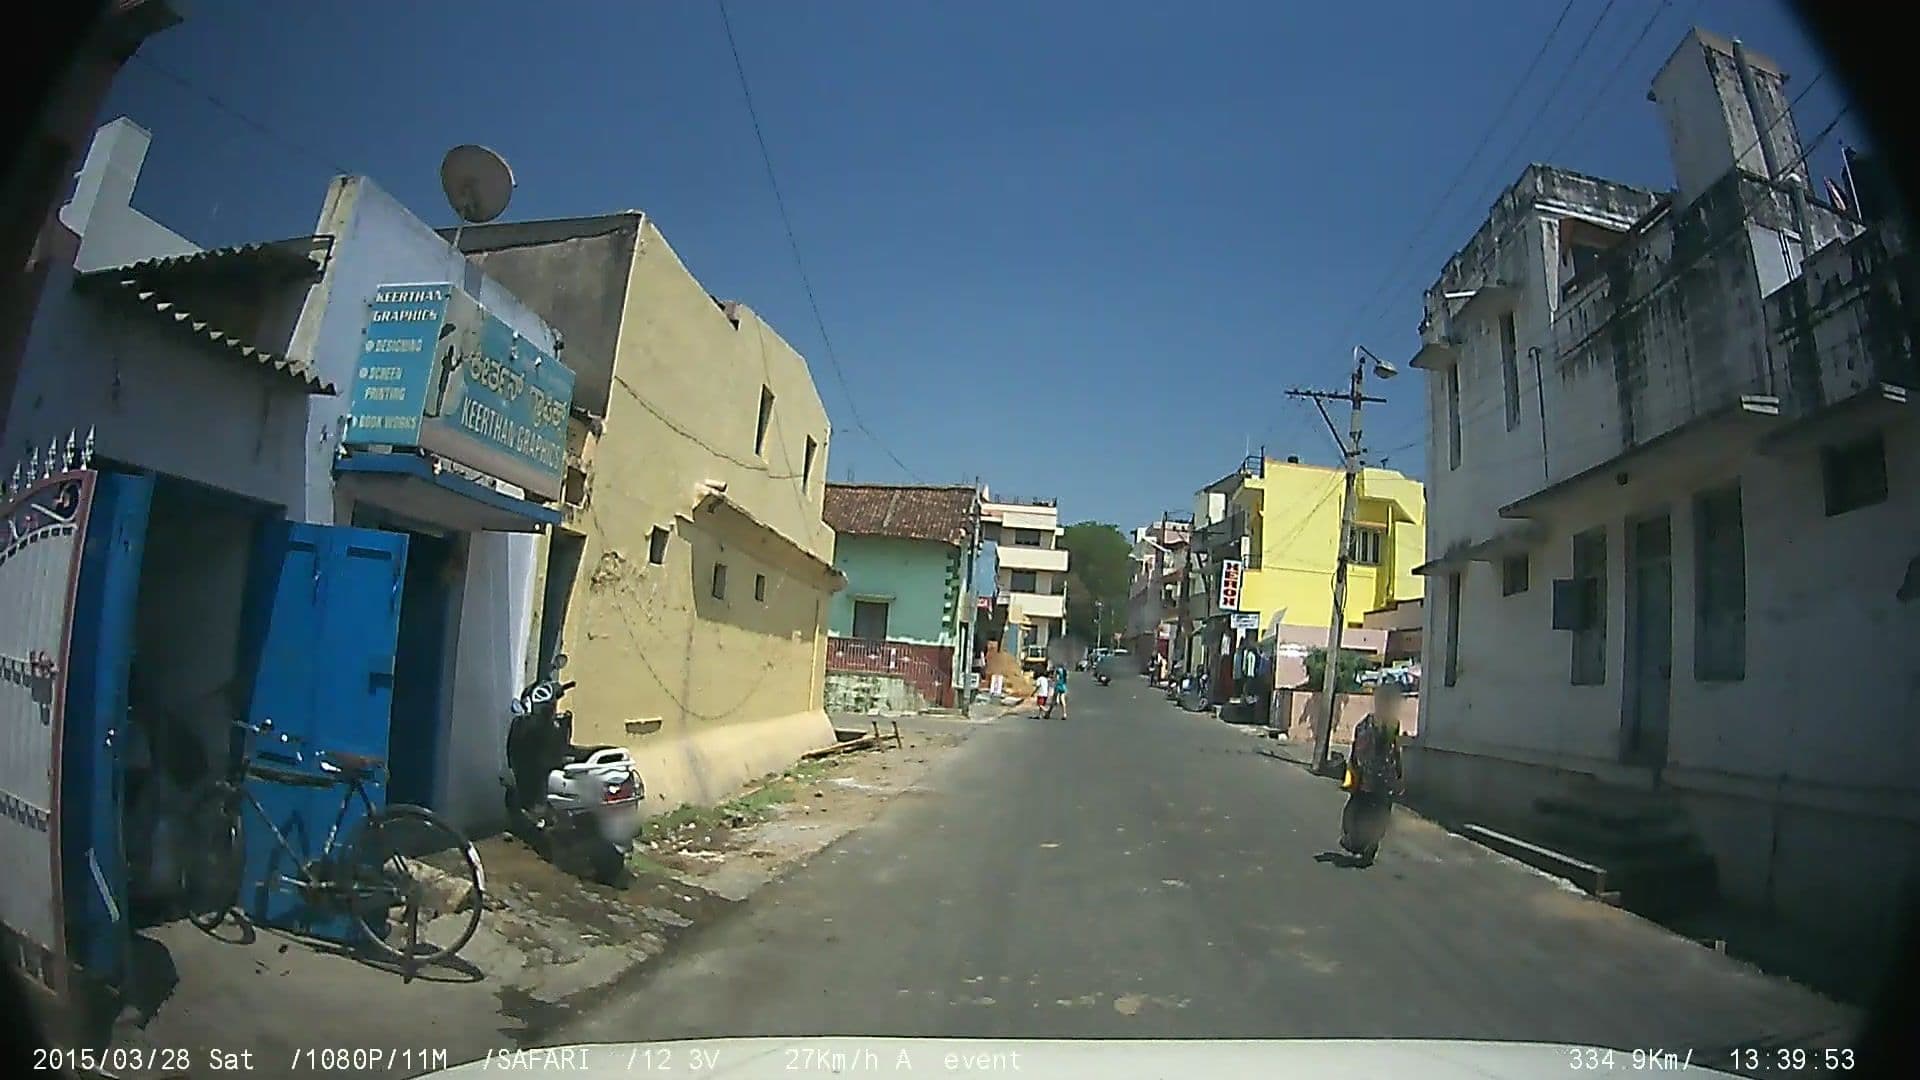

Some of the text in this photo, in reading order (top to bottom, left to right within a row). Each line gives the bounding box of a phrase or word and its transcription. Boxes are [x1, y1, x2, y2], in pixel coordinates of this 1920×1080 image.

[375, 290, 442, 303] KEERTHAN
[373, 309, 437, 322] GRAPHICS
[375, 339, 423, 353] DESIGNING
[368, 367, 403, 381] SCREEN
[364, 387, 406, 401] PRINTING
[359, 415, 417, 430] BOOK WORKS
[461, 397, 561, 470] KEERTHAN GRAPHICS
